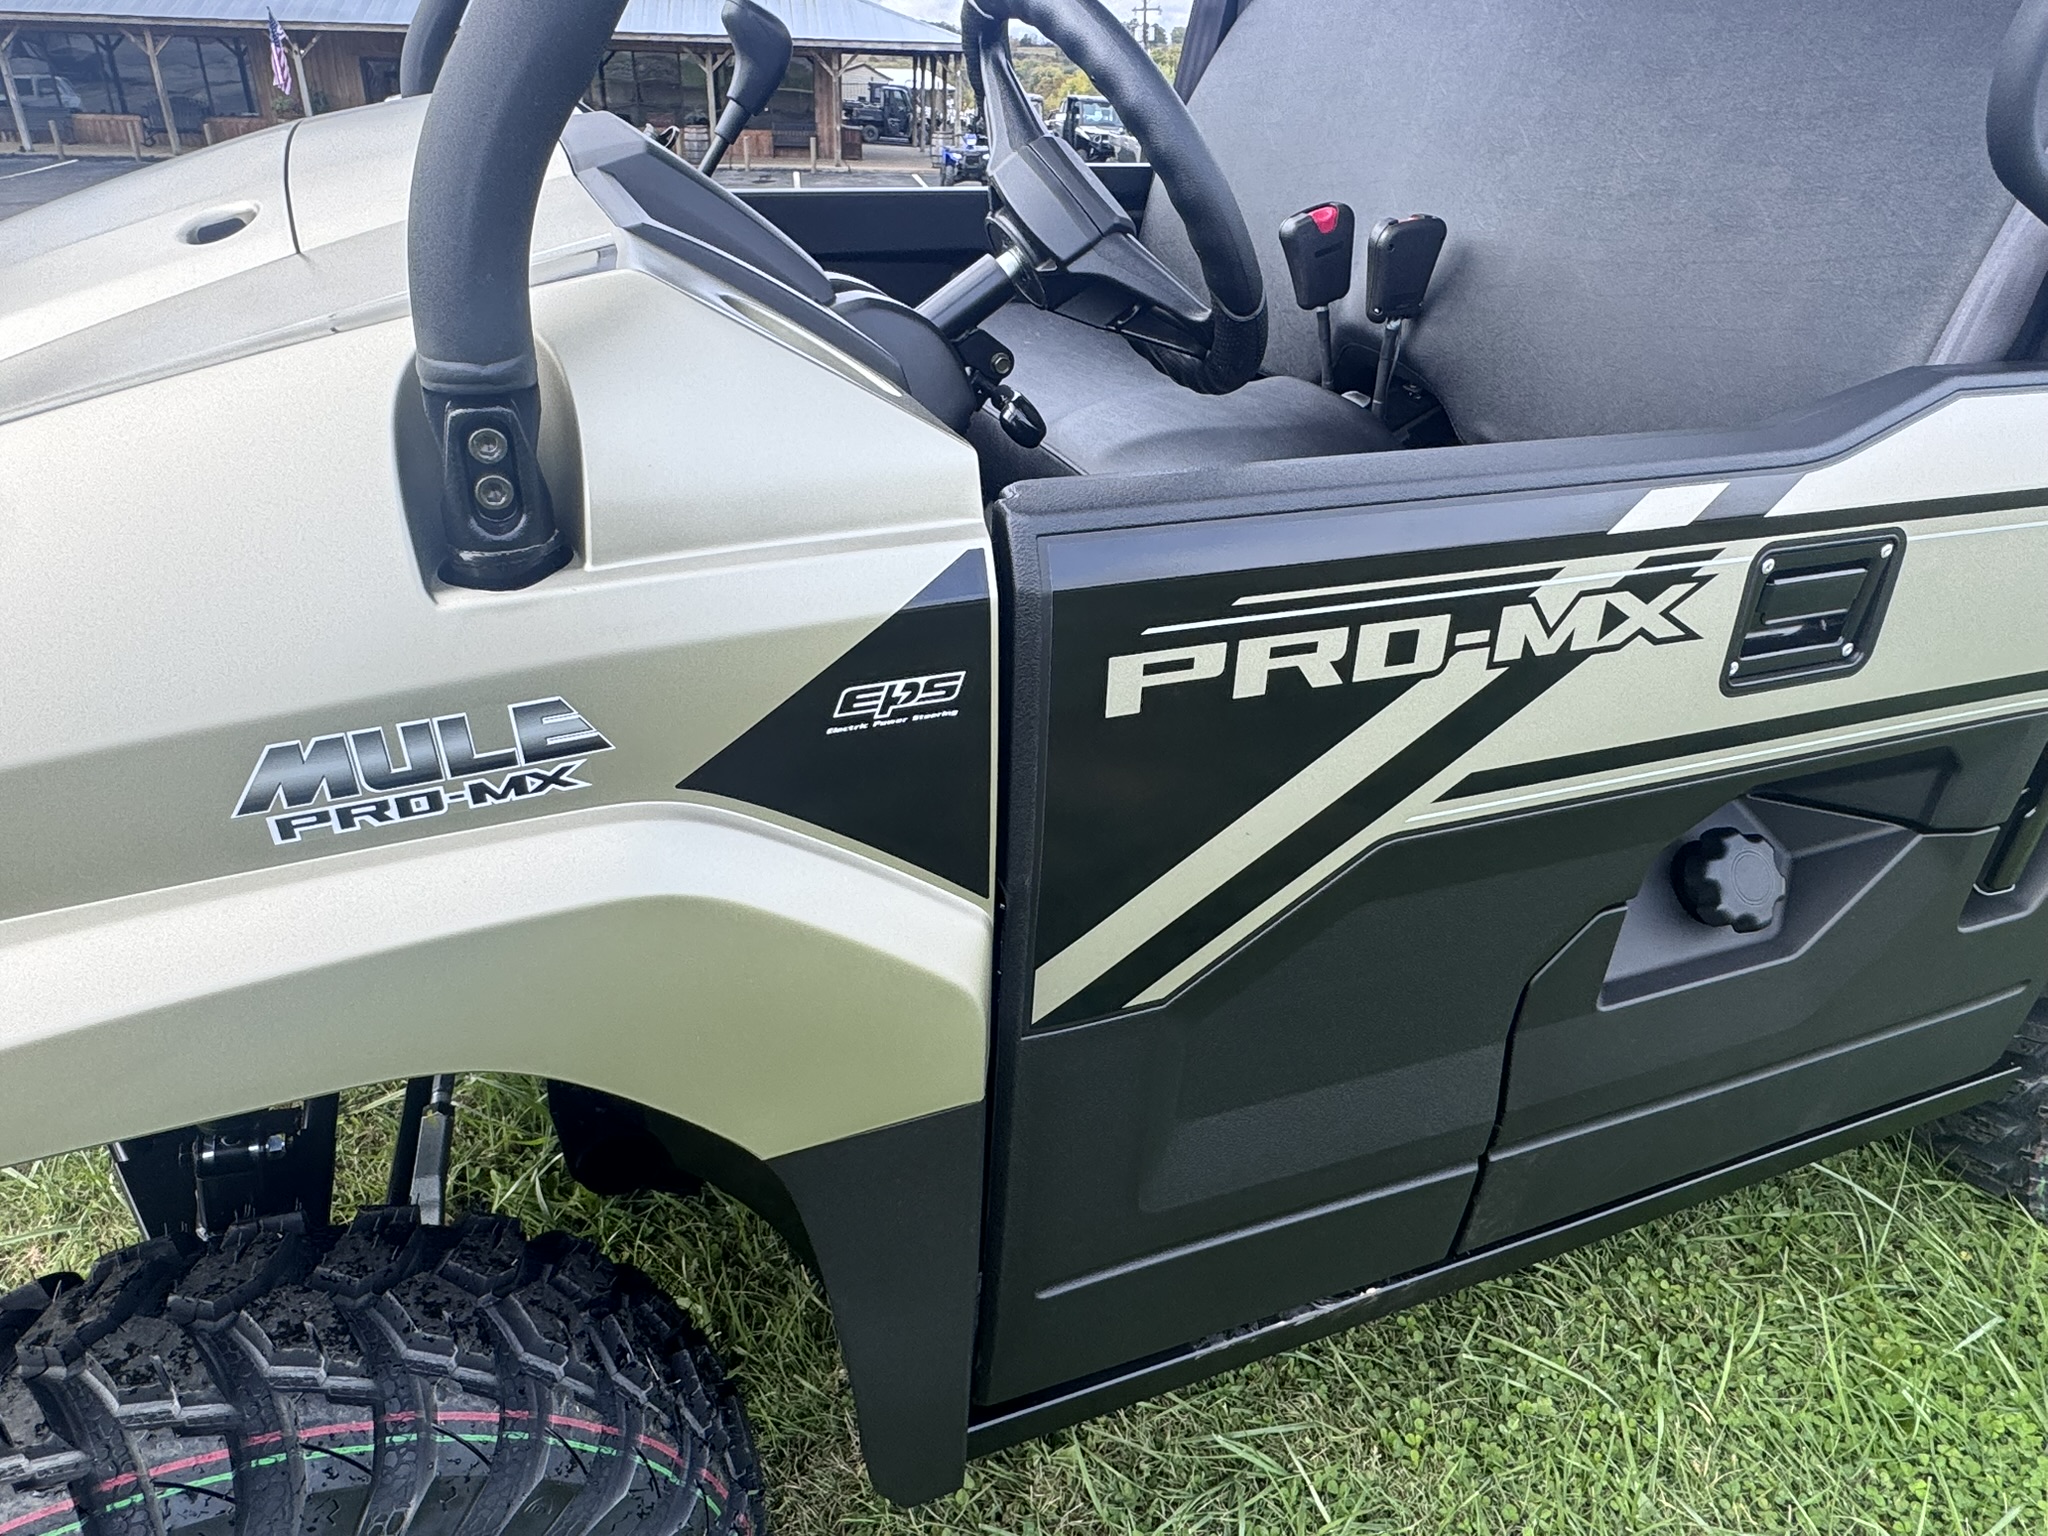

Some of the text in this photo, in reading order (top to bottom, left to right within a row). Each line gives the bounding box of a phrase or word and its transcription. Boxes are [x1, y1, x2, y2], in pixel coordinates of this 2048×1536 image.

[1105, 583, 1705, 718] PRO-MX
[231, 696, 616, 818] MULE
[825, 709, 959, 735] Electric Power Steering
[266, 759, 593, 846] PRO-MX
